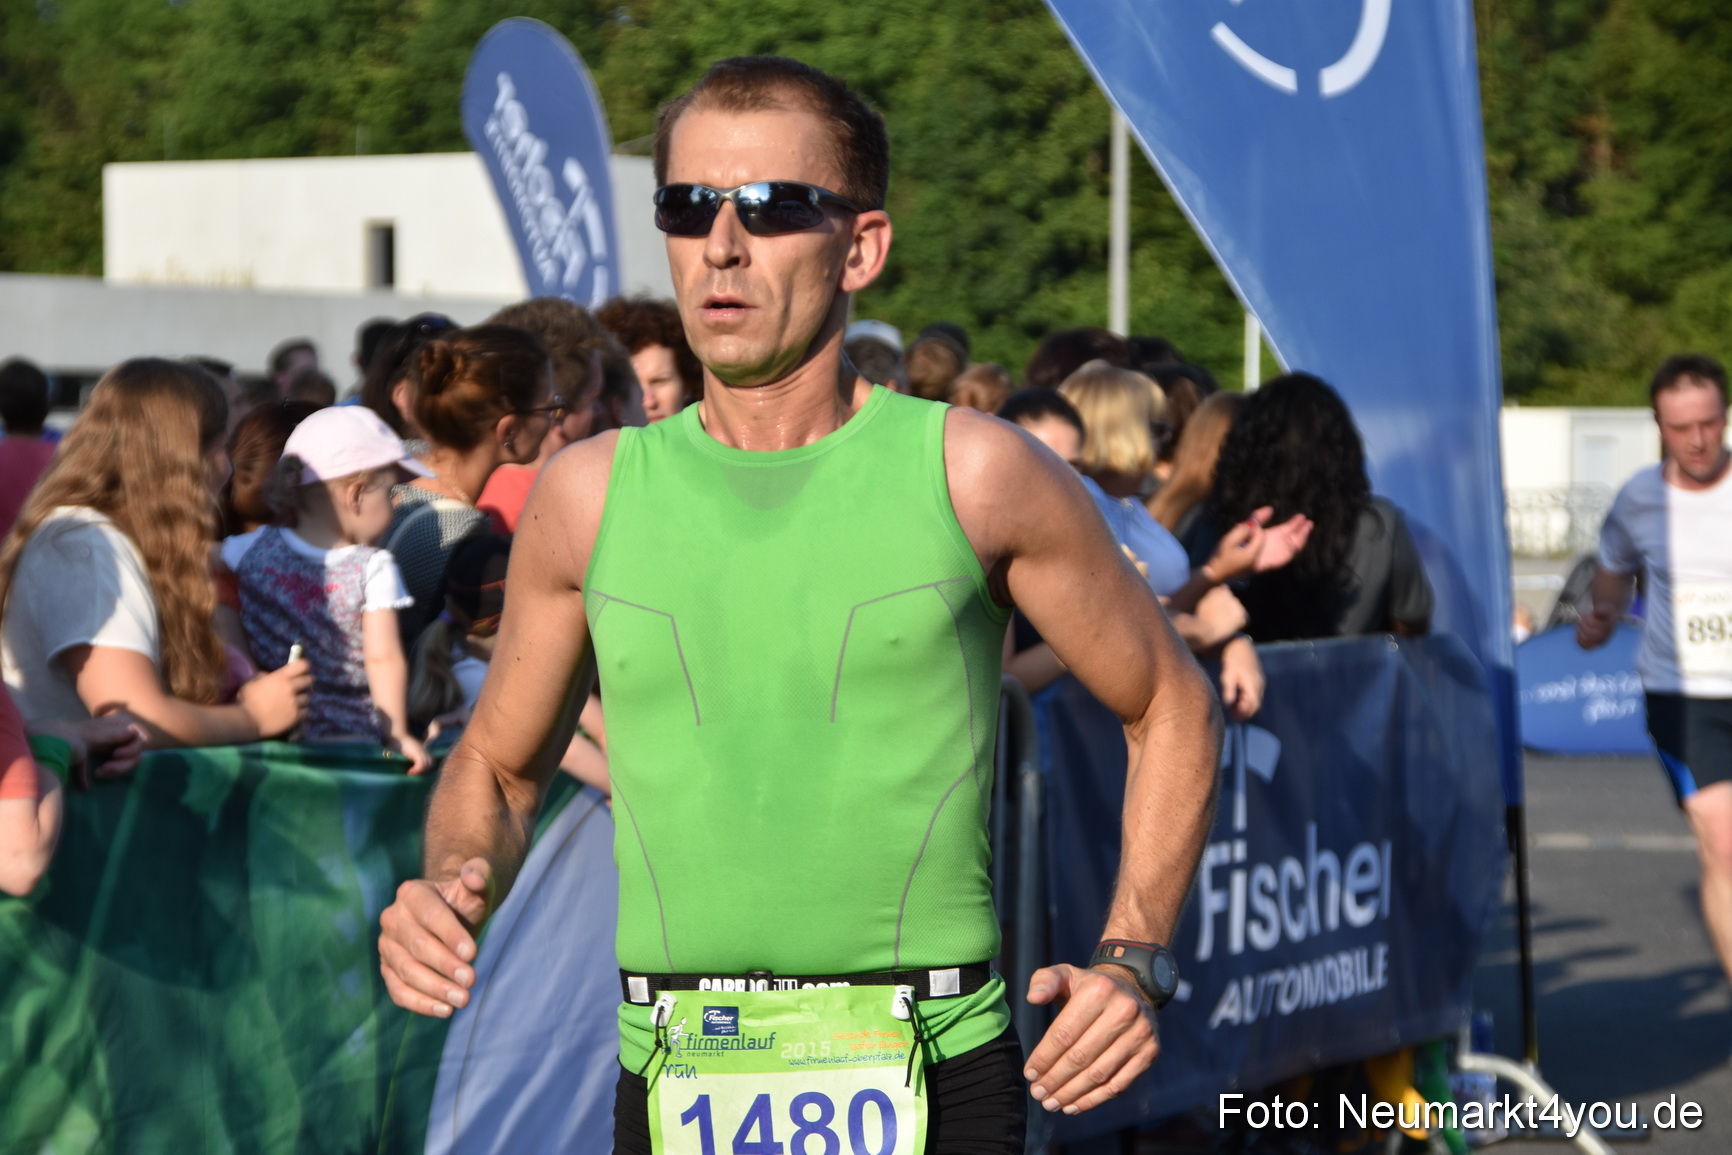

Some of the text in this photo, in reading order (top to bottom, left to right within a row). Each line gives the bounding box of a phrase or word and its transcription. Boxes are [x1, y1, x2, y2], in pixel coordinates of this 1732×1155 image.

[1208, 943, 1389, 1030] AUTOMOBILE
[686, 1032, 776, 1050] firmenlauf
[780, 1040, 832, 1059] 2015
[788, 1051, 906, 1066] www.firmenlauf-oberpfalz.de
[680, 1088, 898, 1155] 1480
